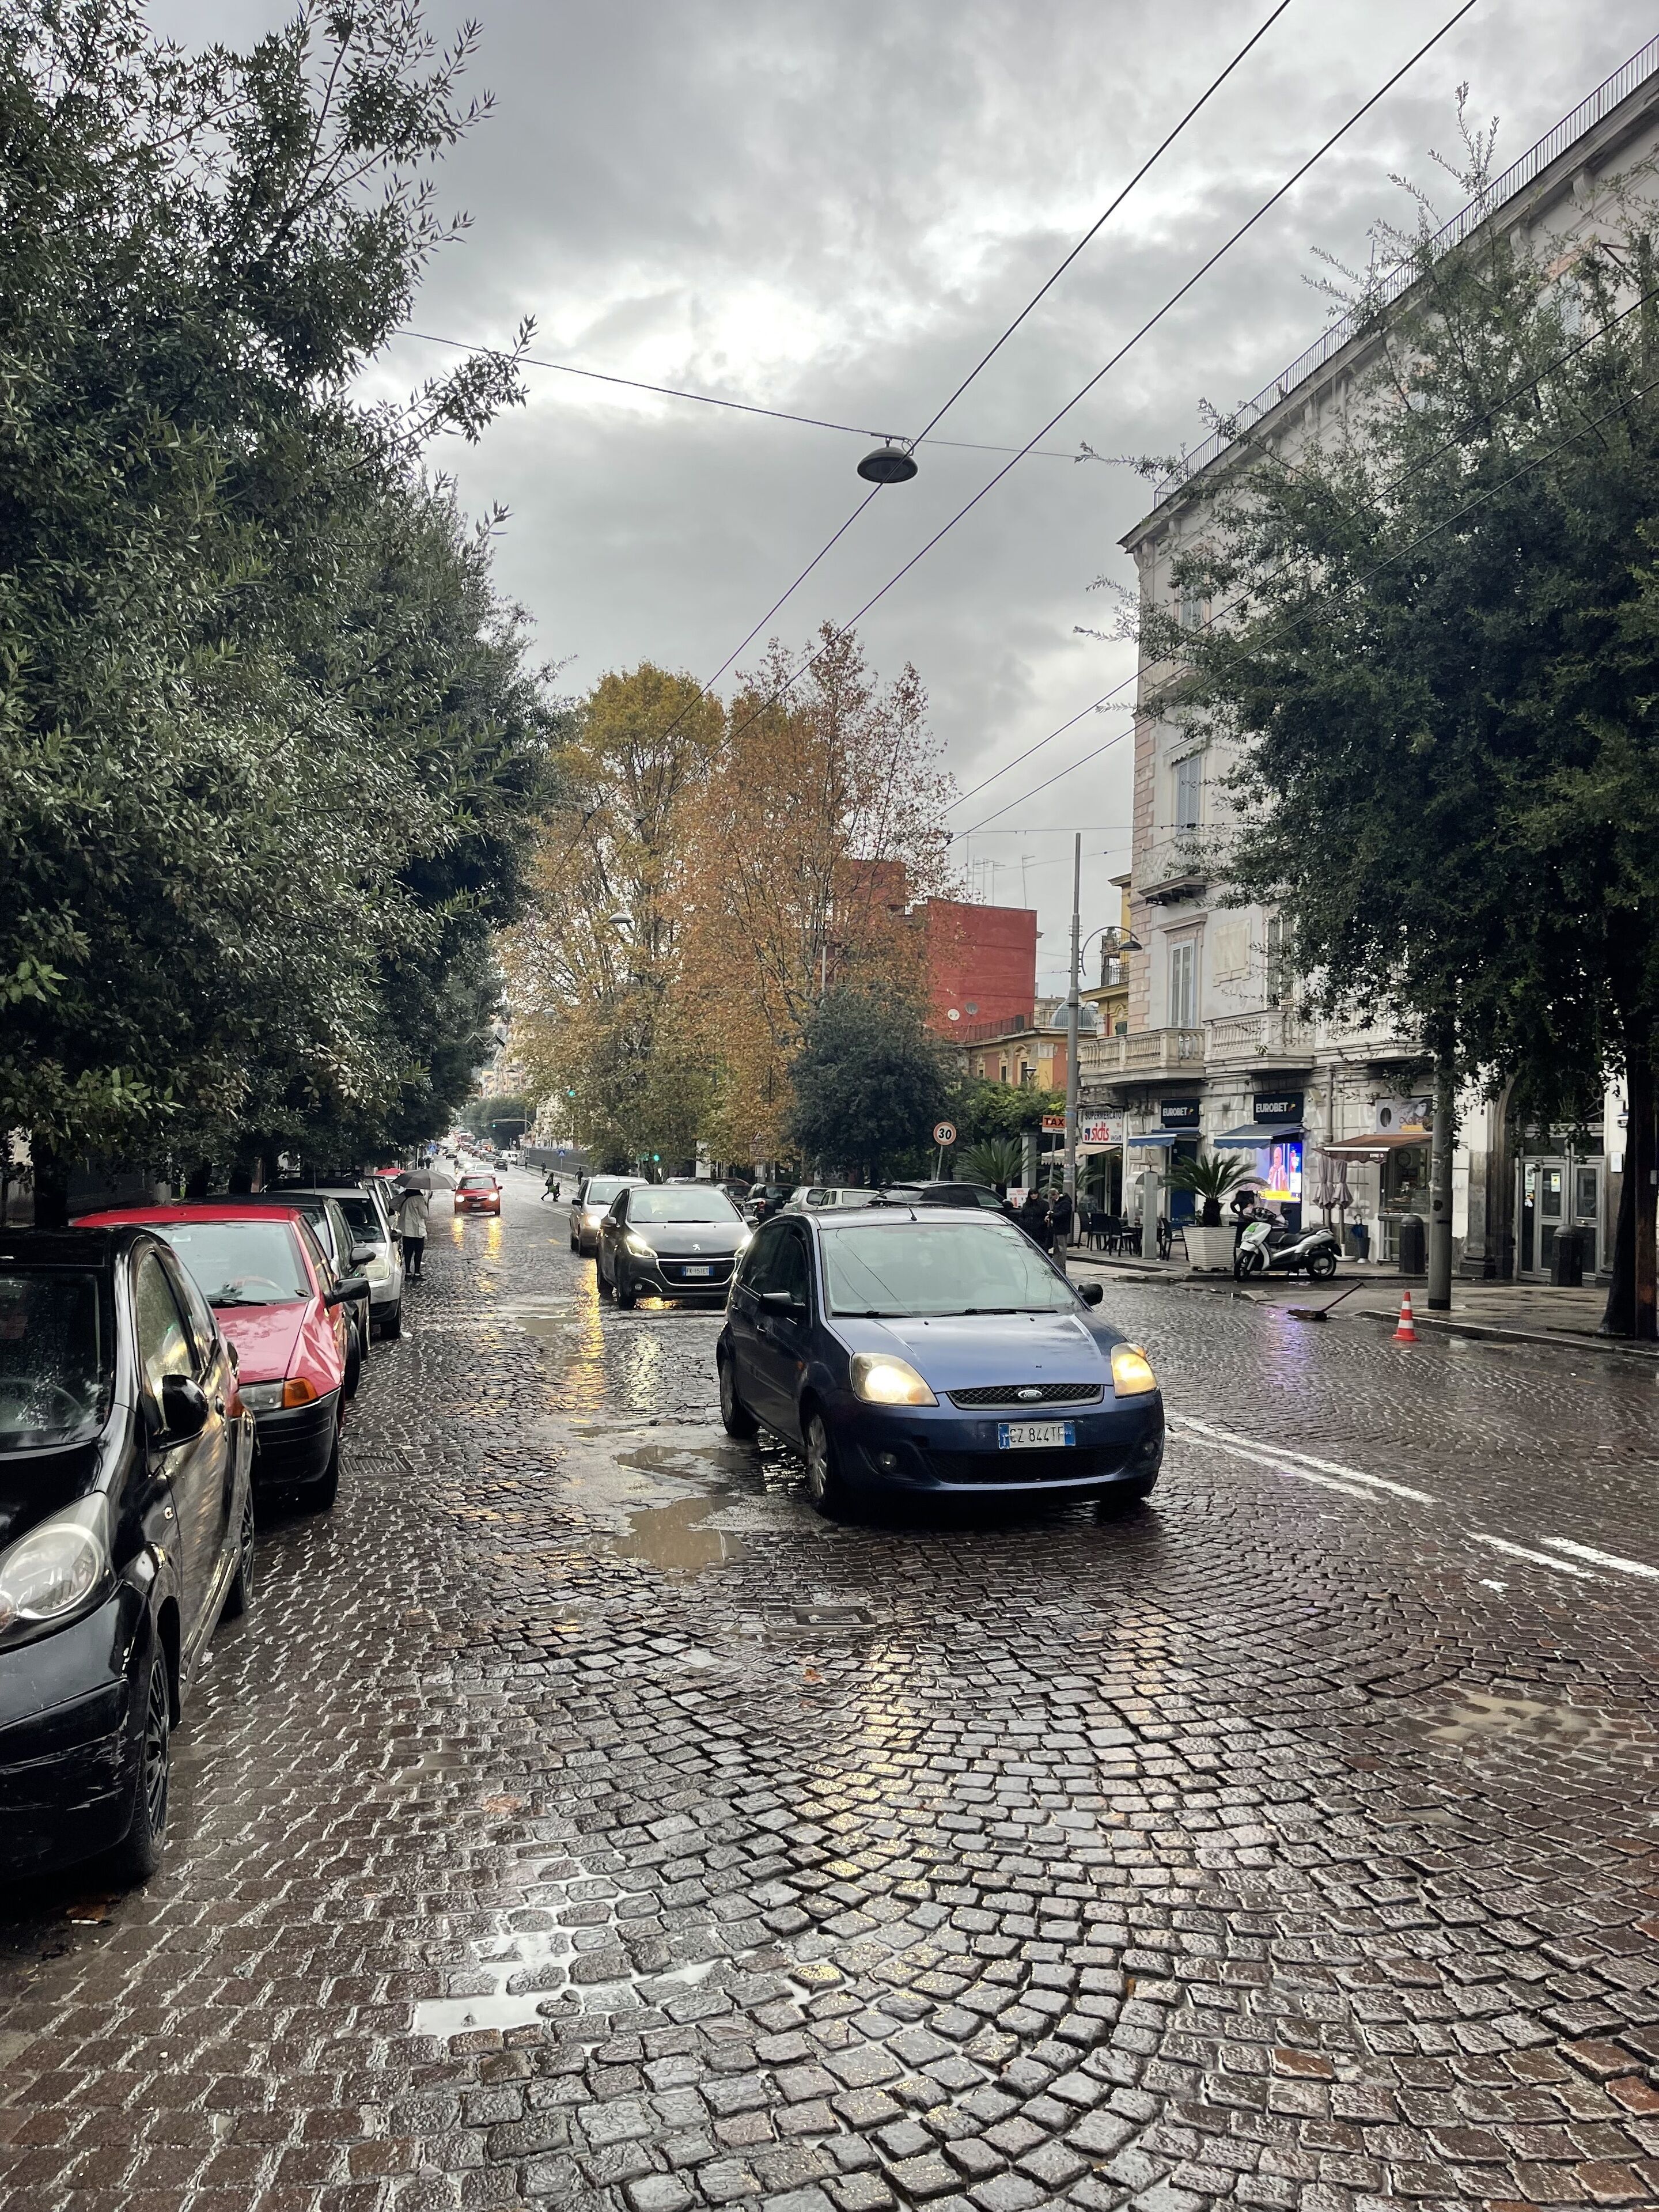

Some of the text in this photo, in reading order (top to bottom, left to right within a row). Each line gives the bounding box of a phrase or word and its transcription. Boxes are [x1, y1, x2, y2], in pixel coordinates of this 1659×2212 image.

[1163, 1107, 1187, 1116] EUROBET
[1256, 1102, 1288, 1112] EUROBET
[1085, 1110, 1122, 1119] SUPERMERCATO
[1044, 1118, 1066, 1126] TAX
[939, 1128, 952, 1139] 30
[1091, 1121, 1109, 1141] sidis
[1010, 1428, 1024, 1442] CZ
